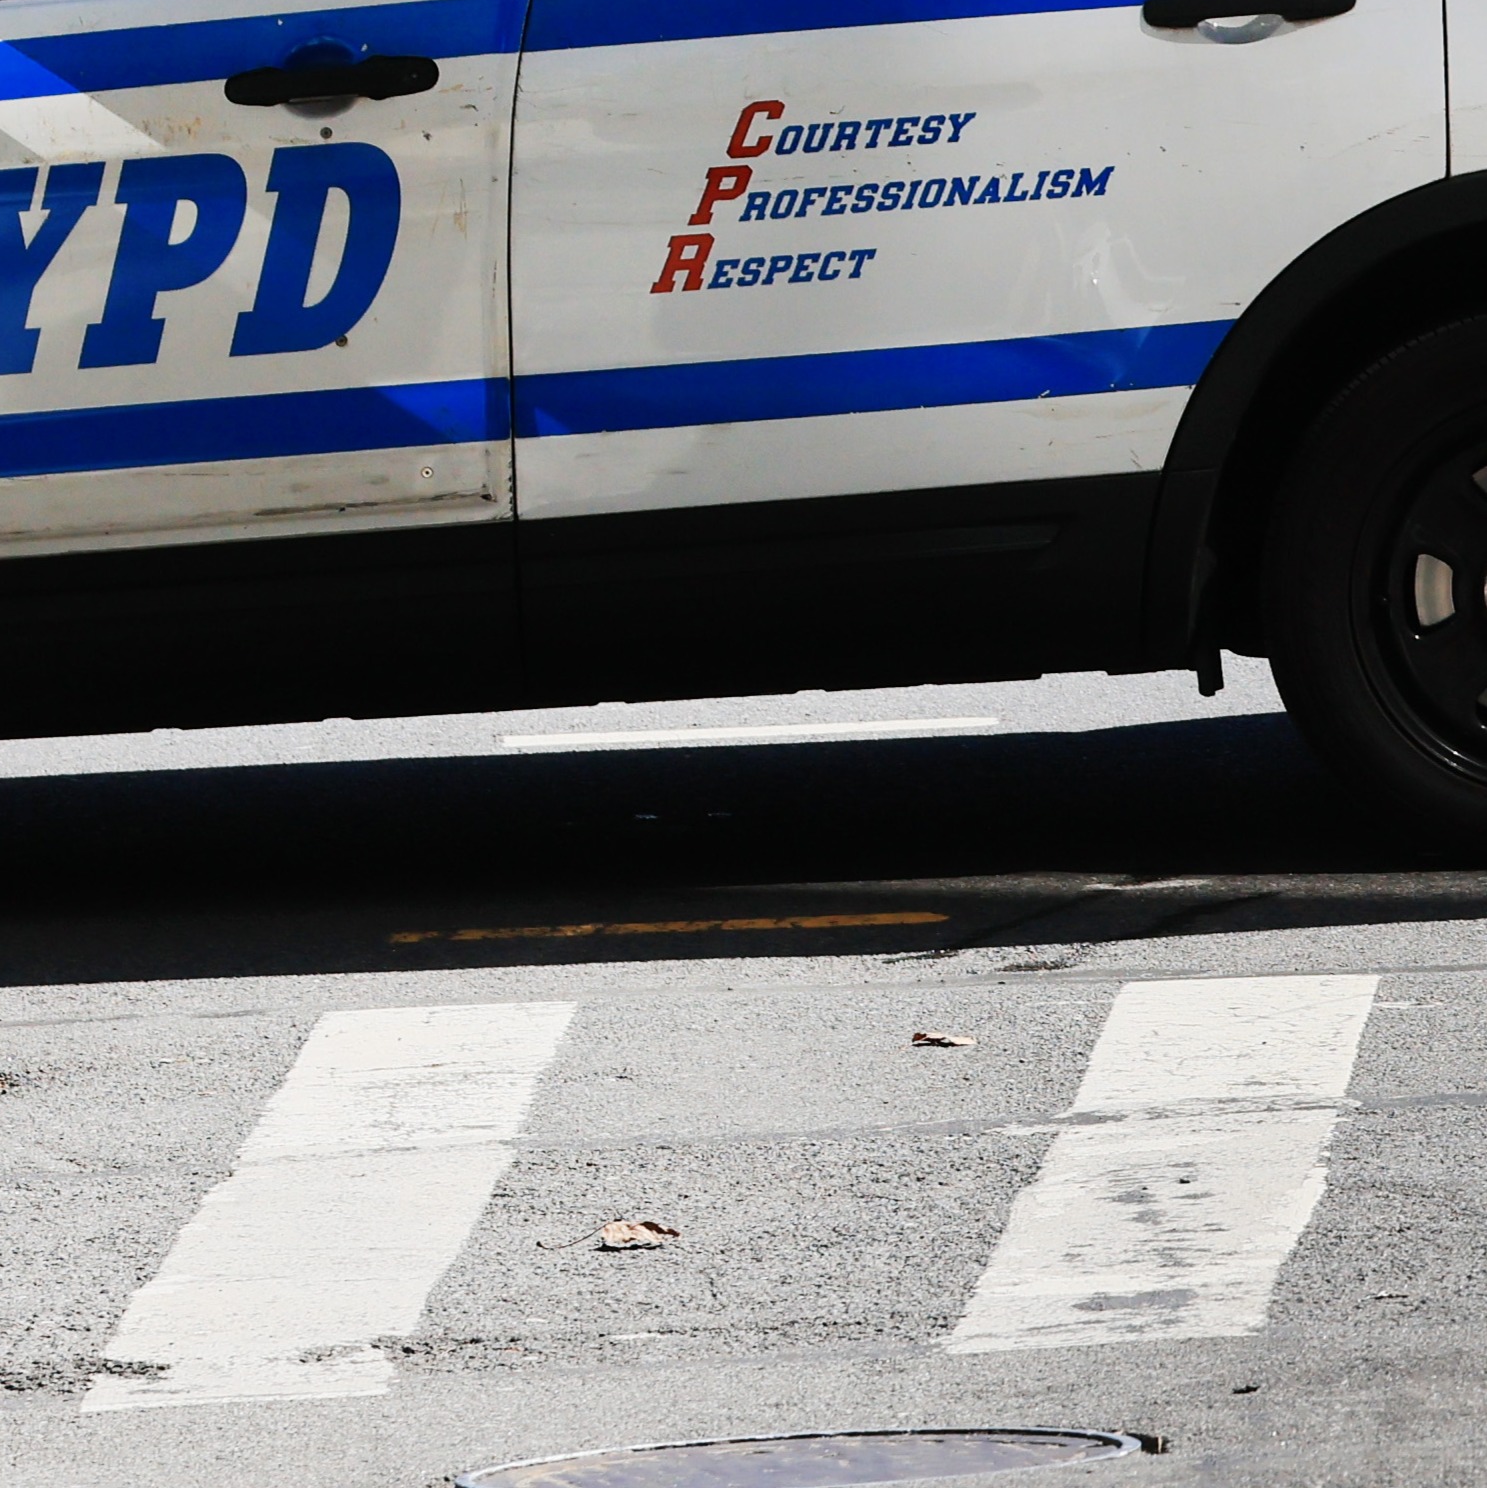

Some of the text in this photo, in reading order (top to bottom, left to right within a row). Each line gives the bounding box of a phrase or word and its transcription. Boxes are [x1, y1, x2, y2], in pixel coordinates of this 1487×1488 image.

[726, 100, 976, 159] COURTESY
[687, 164, 1115, 226] PROFESSIONALISM
[649, 232, 877, 294] RESPECT
